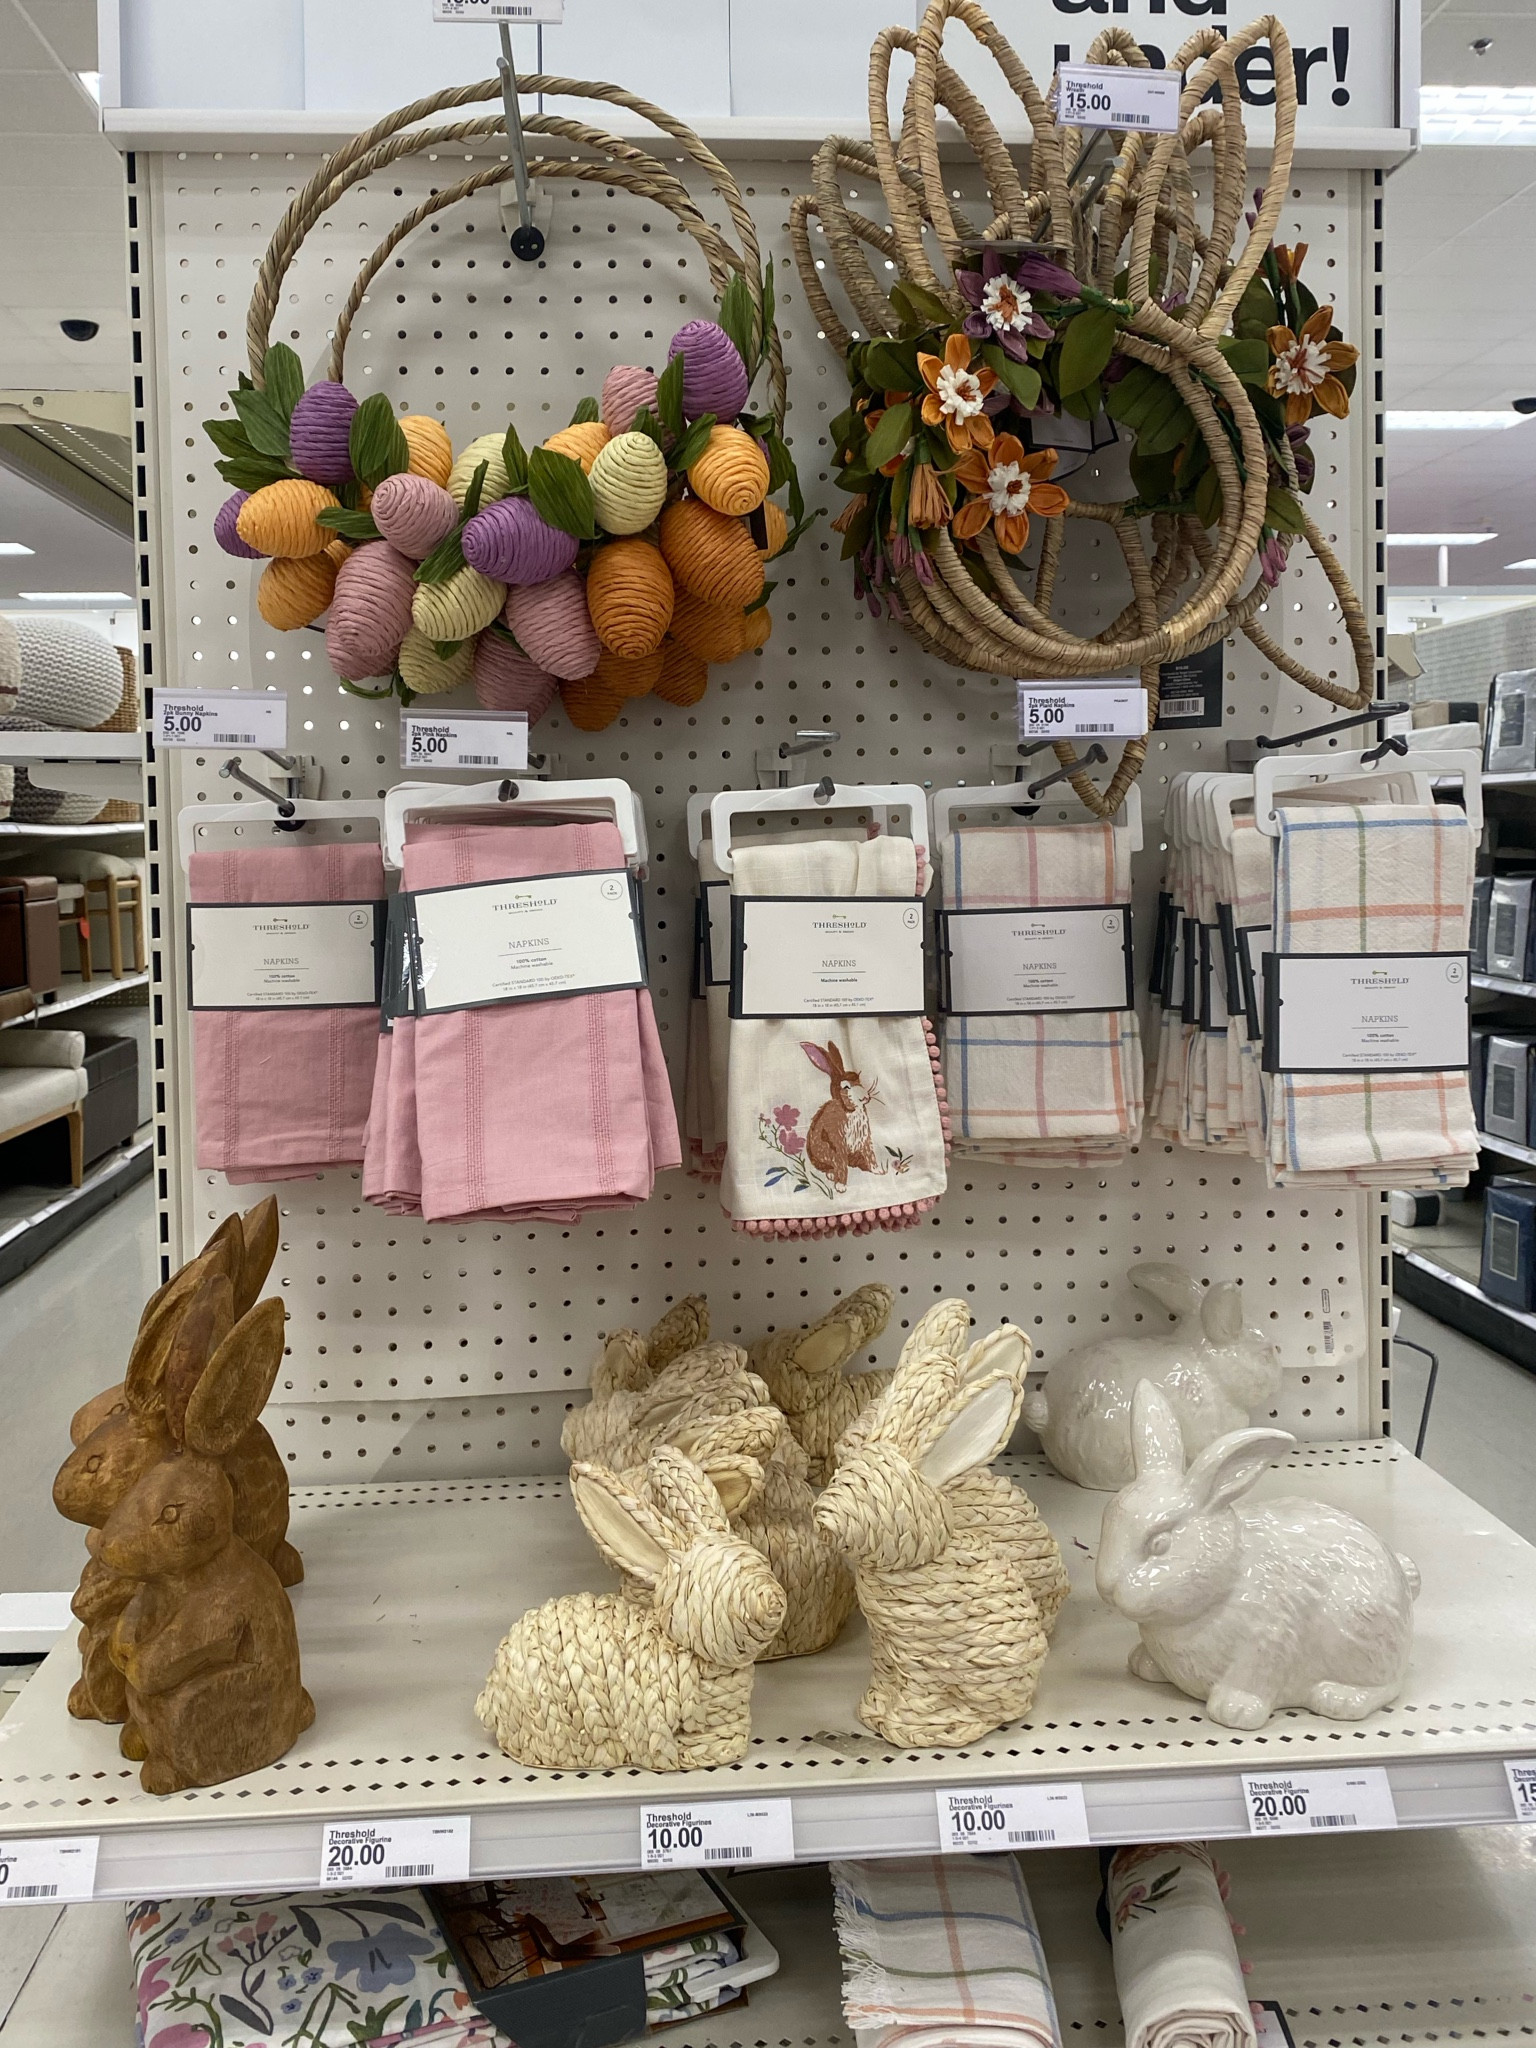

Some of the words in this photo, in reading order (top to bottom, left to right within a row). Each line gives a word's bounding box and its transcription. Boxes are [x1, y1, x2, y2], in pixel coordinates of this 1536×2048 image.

[1066, 80, 1104, 90] Threshold
[1066, 92, 1111, 111] 15.00
[163, 704, 204, 712] Threshold
[1029, 708, 1064, 723] 5.00
[163, 716, 202, 732] 5.00
[411, 725, 450, 734] Threshold
[411, 737, 448, 753] 5.00
[508, 937, 550, 949] NAPKINS
[1361, 1015, 1399, 1023] NAPKINS
[1248, 1780, 1292, 1790] Threshold
[1249, 1789, 1282, 1797] Decorative
[1283, 1788, 1310, 1796] Figurine
[948, 1795, 993, 1805] Threshold
[983, 1803, 1013, 1811] Figurines
[1252, 1795, 1307, 1817] 20.00
[646, 1812, 692, 1822] Threshold
[951, 1810, 1005, 1832] 10.00
[646, 1821, 680, 1829] Decorative
[682, 1820, 712, 1828] Figurines
[329, 1828, 376, 1839] Threshold
[648, 1827, 703, 1849] 10.00
[365, 1836, 392, 1844] Figurine
[327, 1844, 385, 1867] 20.00
